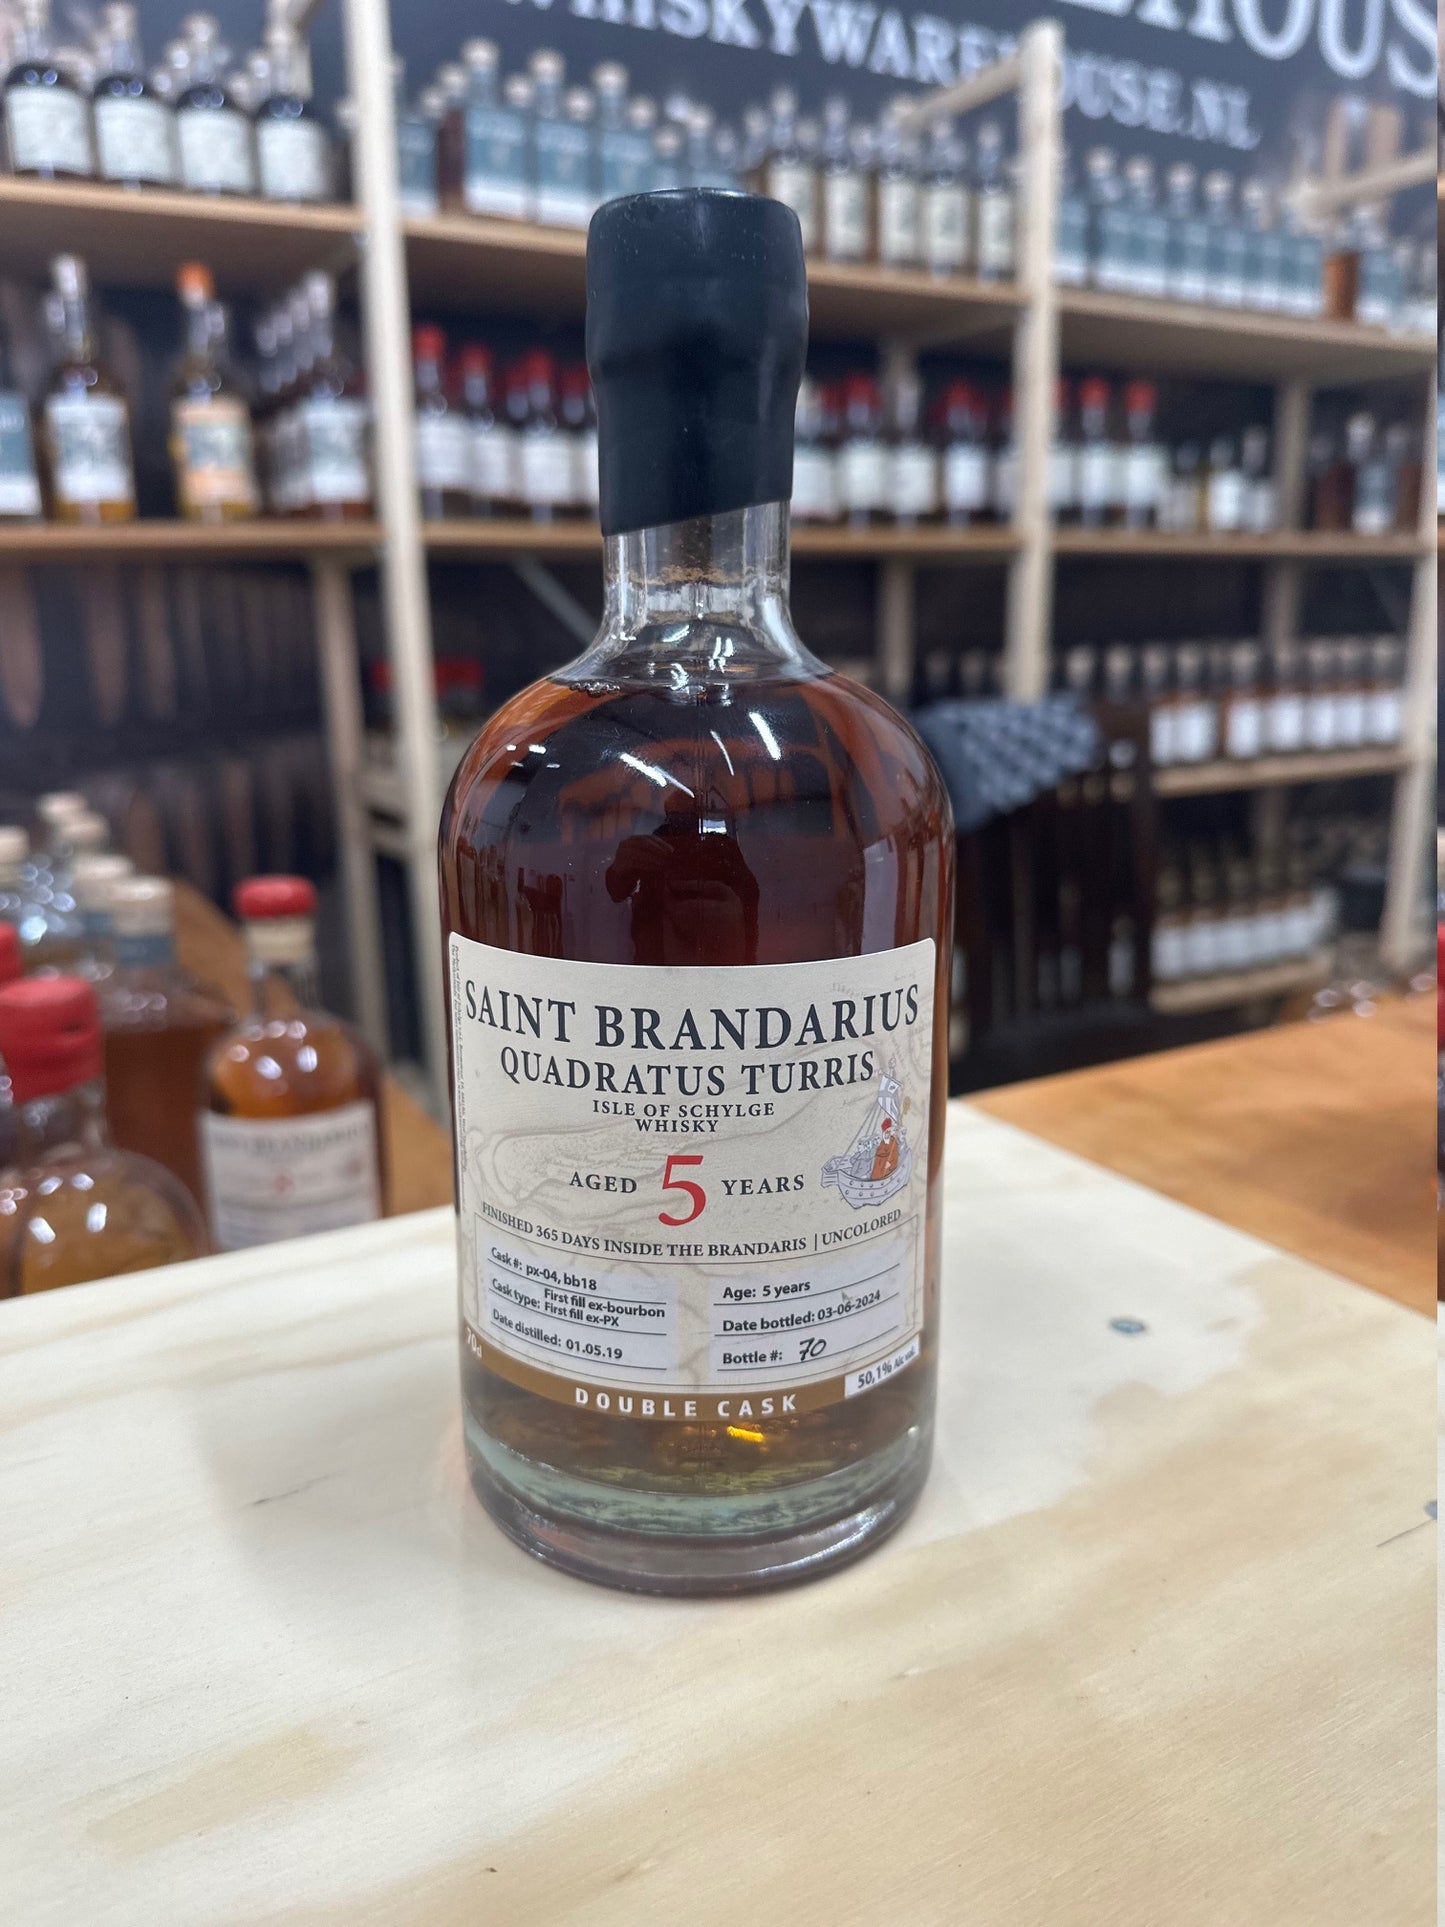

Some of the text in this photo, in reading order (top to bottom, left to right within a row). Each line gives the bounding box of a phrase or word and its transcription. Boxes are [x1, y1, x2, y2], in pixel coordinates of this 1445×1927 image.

[465, 979, 576, 1043] SAINT
[594, 984, 918, 1051] BRANDARIUS
[500, 1046, 874, 1096] QUADRATUS TURRIS
[592, 1099, 775, 1118] ISLE OF SCHYLGE
[635, 1118, 719, 1133] WHISKY
[569, 1154, 805, 1227] AGED 5 YEARS
[482, 1202, 534, 1234] FINISHED
[536, 1225, 559, 1242] 365
[561, 1232, 601, 1251] DAYS
[604, 1239, 664, 1257] INSIDE
[667, 1244, 704, 1257] THE
[707, 1237, 807, 1257] BRANDARIS
[821, 1208, 902, 1245] UNCOLORED
[491, 1246, 513, 1266] Cask
[525, 1263, 561, 1285] px-04,
[563, 1272, 597, 1291] bb18
[491, 1278, 620, 1327] Cask type: First fill ex-PX
[543, 1287, 666, 1318] First fill ex-bourbon
[722, 1280, 811, 1302] Age: 5 years
[722, 1289, 881, 1332] Date bottled: 03-06-2024
[492, 1307, 623, 1360] Date distilled: 01.05.19
[798, 1337, 827, 1363] 70
[722, 1350, 767, 1365] Bottle
[857, 1361, 893, 1389] 50,1%
[574, 1387, 797, 1417] DOUBLE CASK
